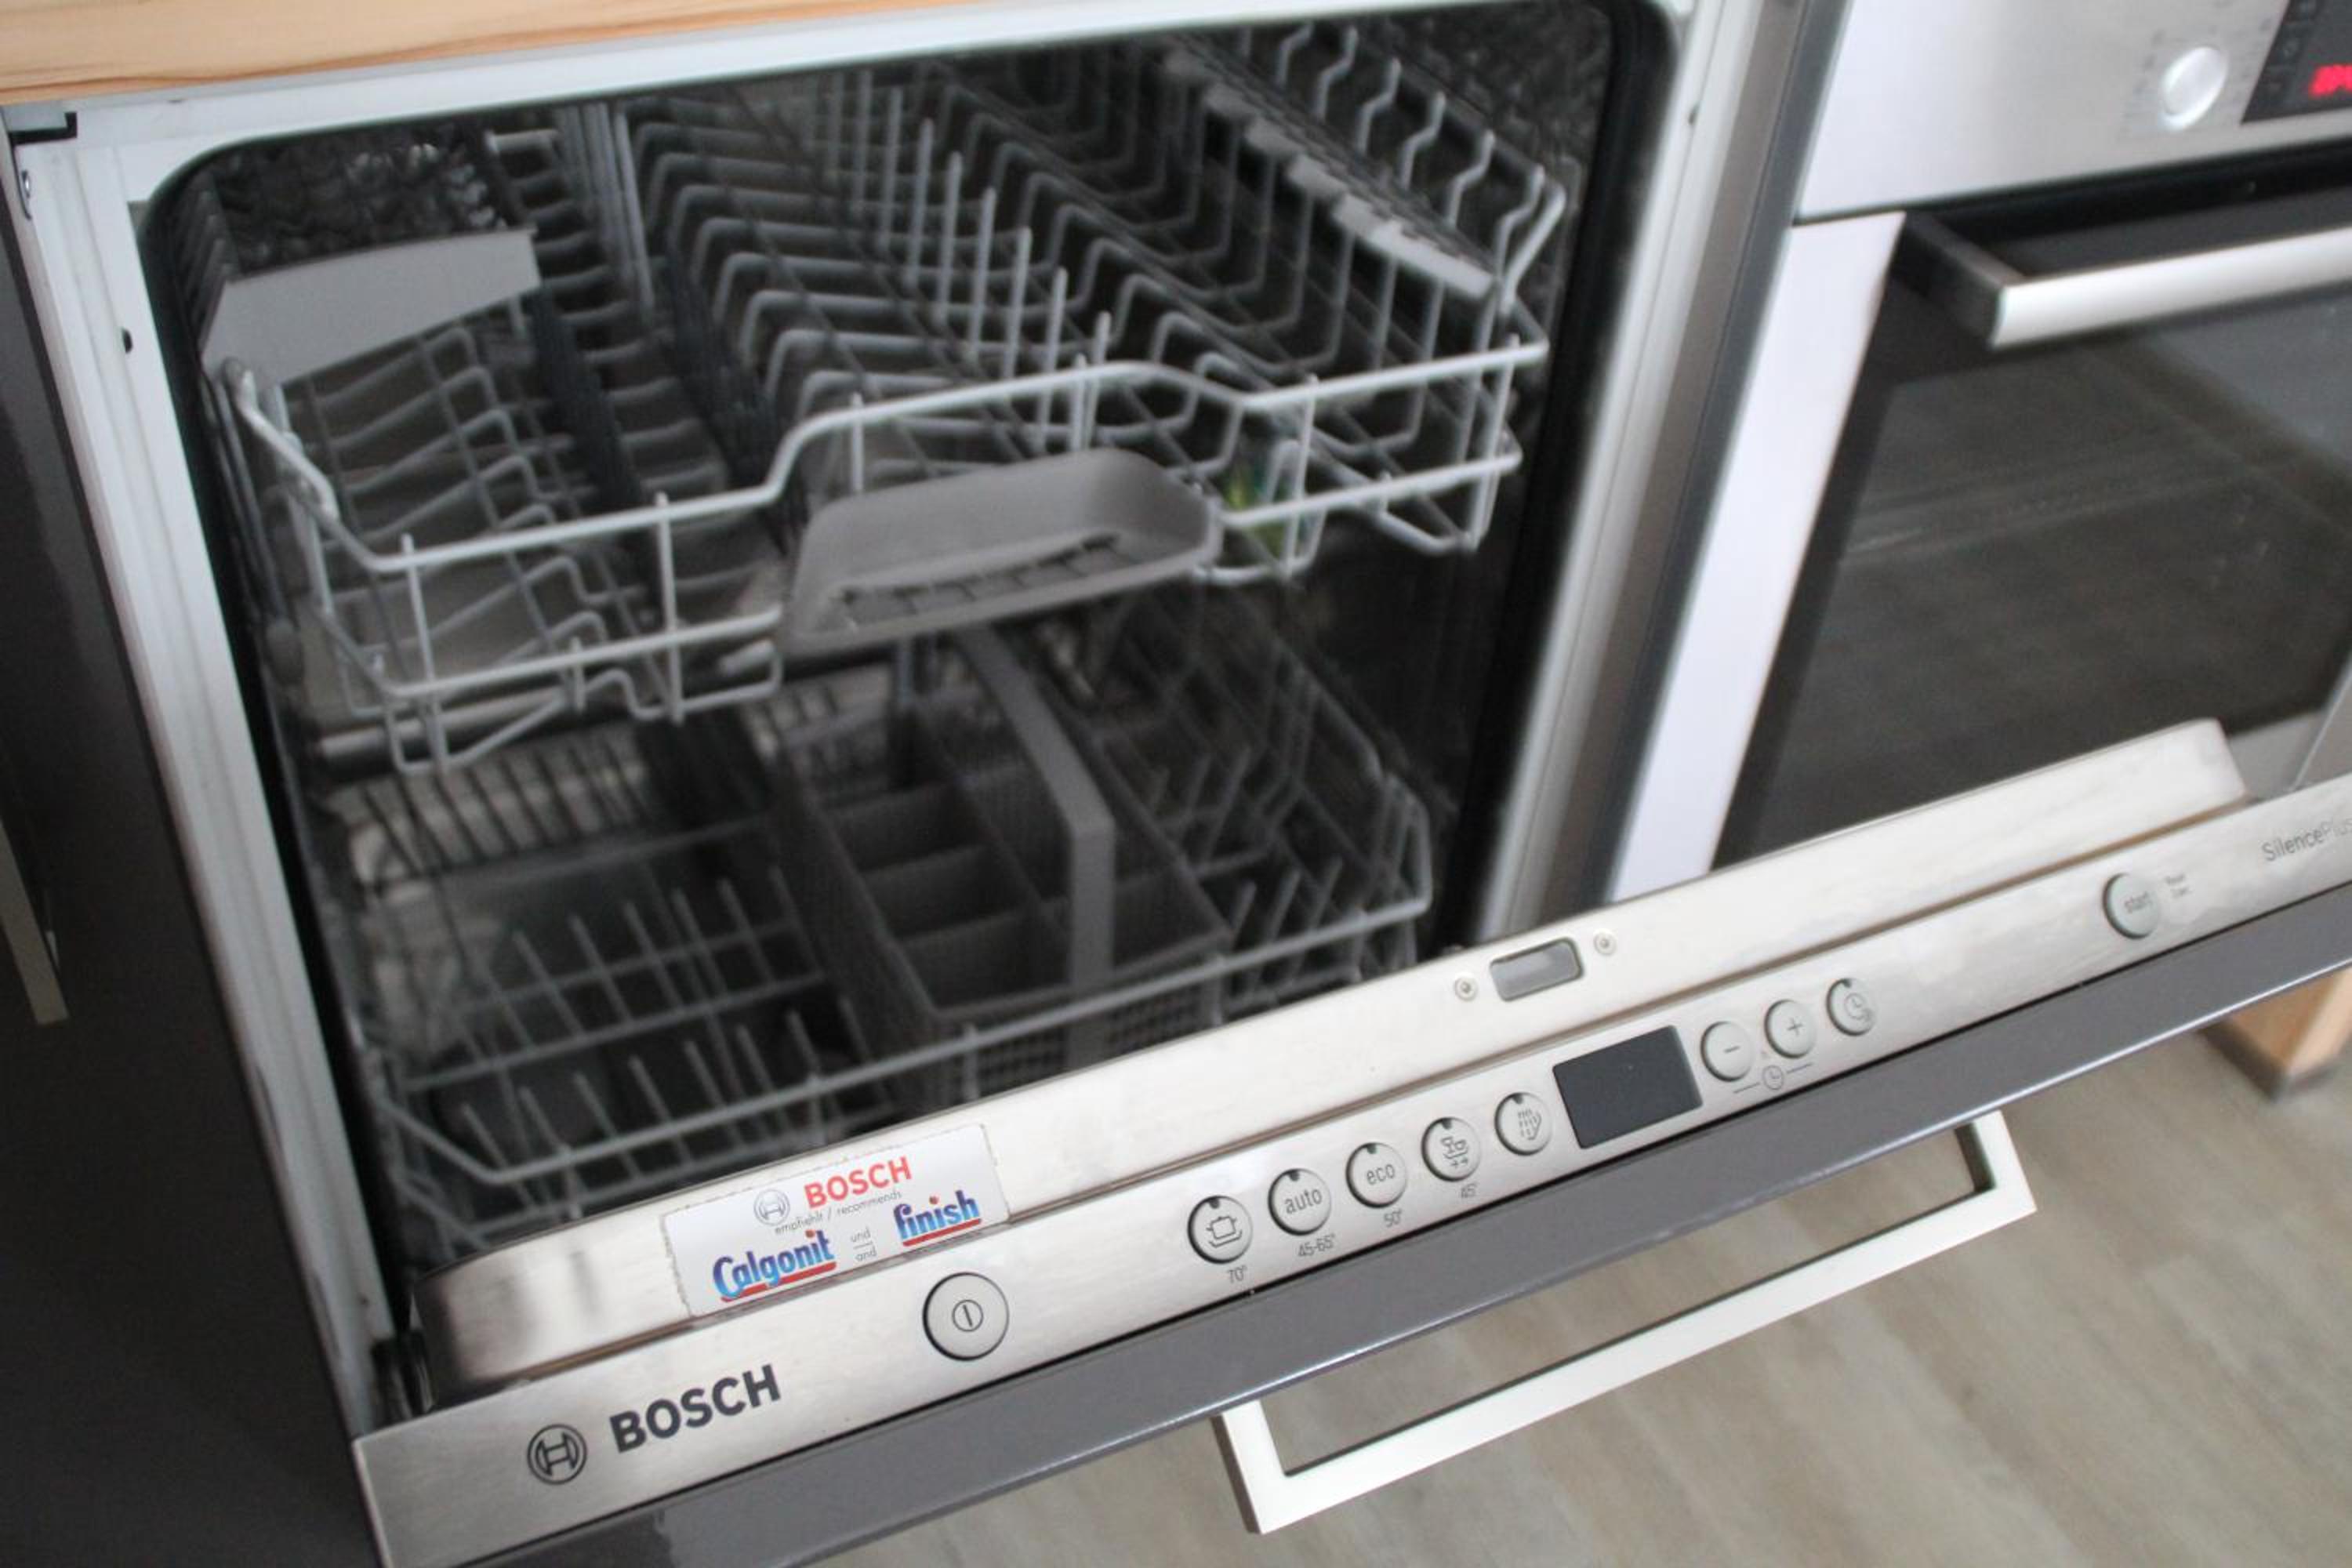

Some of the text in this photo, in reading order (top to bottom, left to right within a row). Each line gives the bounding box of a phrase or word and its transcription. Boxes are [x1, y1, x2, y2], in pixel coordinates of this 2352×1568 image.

[804, 1156, 913, 1208] BOSCH
[1367, 1162, 1396, 1185] eco
[775, 1211, 822, 1235] empfiehlt
[837, 1189, 903, 1215] recommends
[892, 1190, 980, 1240] finish
[1284, 1186, 1323, 1214] auto
[851, 1225, 871, 1243] und
[855, 1245, 877, 1262] and
[712, 1230, 835, 1299] Calgonit
[609, 1363, 782, 1454] BOSCH
